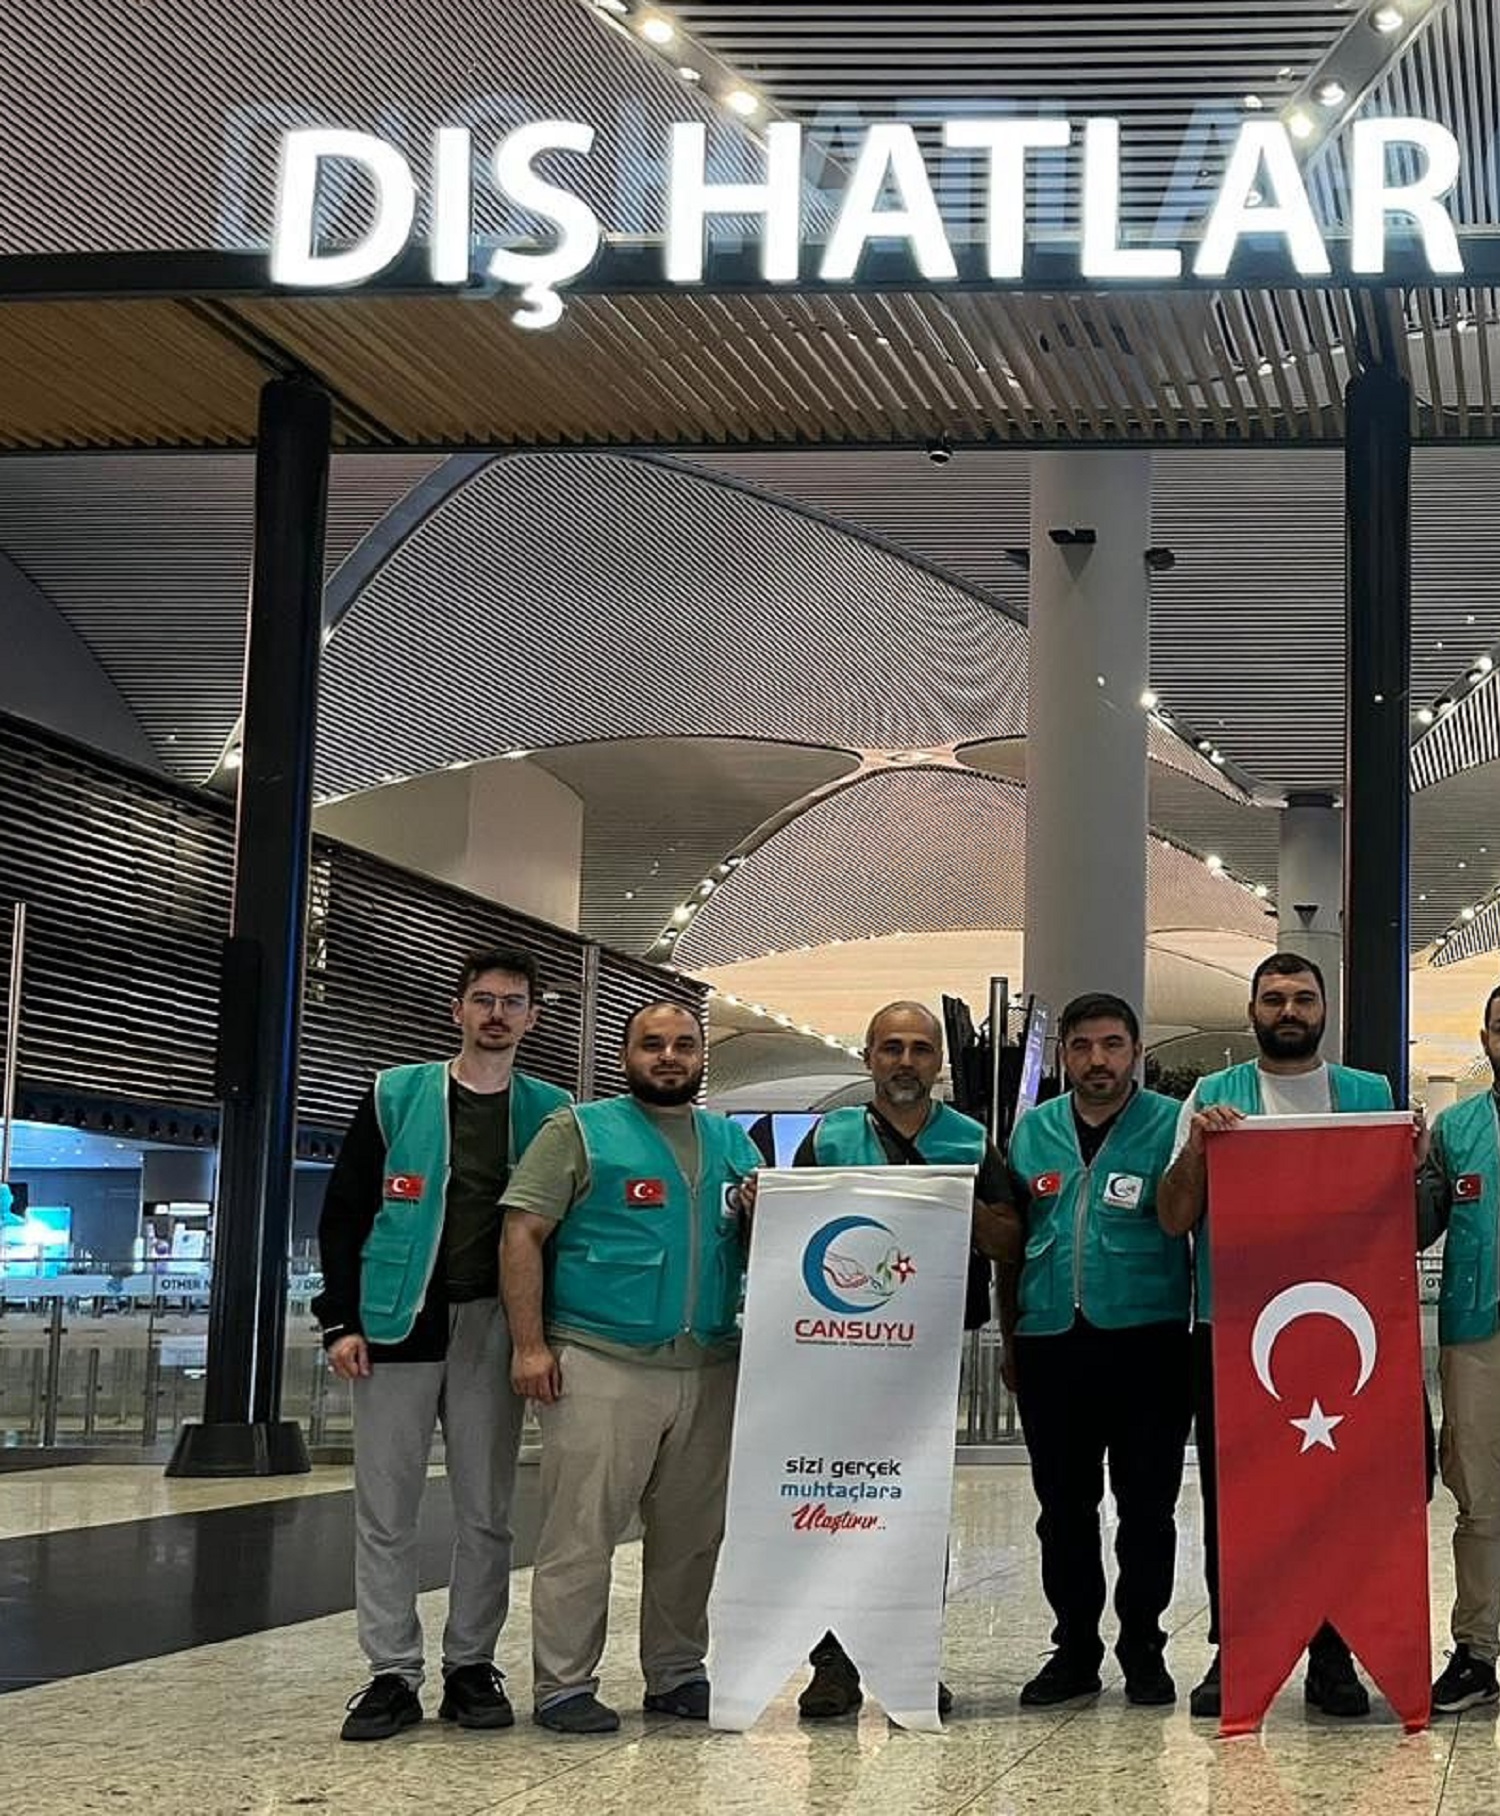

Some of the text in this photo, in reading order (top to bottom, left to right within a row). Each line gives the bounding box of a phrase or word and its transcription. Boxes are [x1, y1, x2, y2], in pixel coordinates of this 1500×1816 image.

[270, 119, 602, 330] DIŞ
[661, 115, 1465, 281] HATLAR
[795, 1319, 915, 1341] CANSUYU
[786, 1457, 901, 1479] sizi gerçek
[780, 1481, 903, 1502] muhtaçlara
